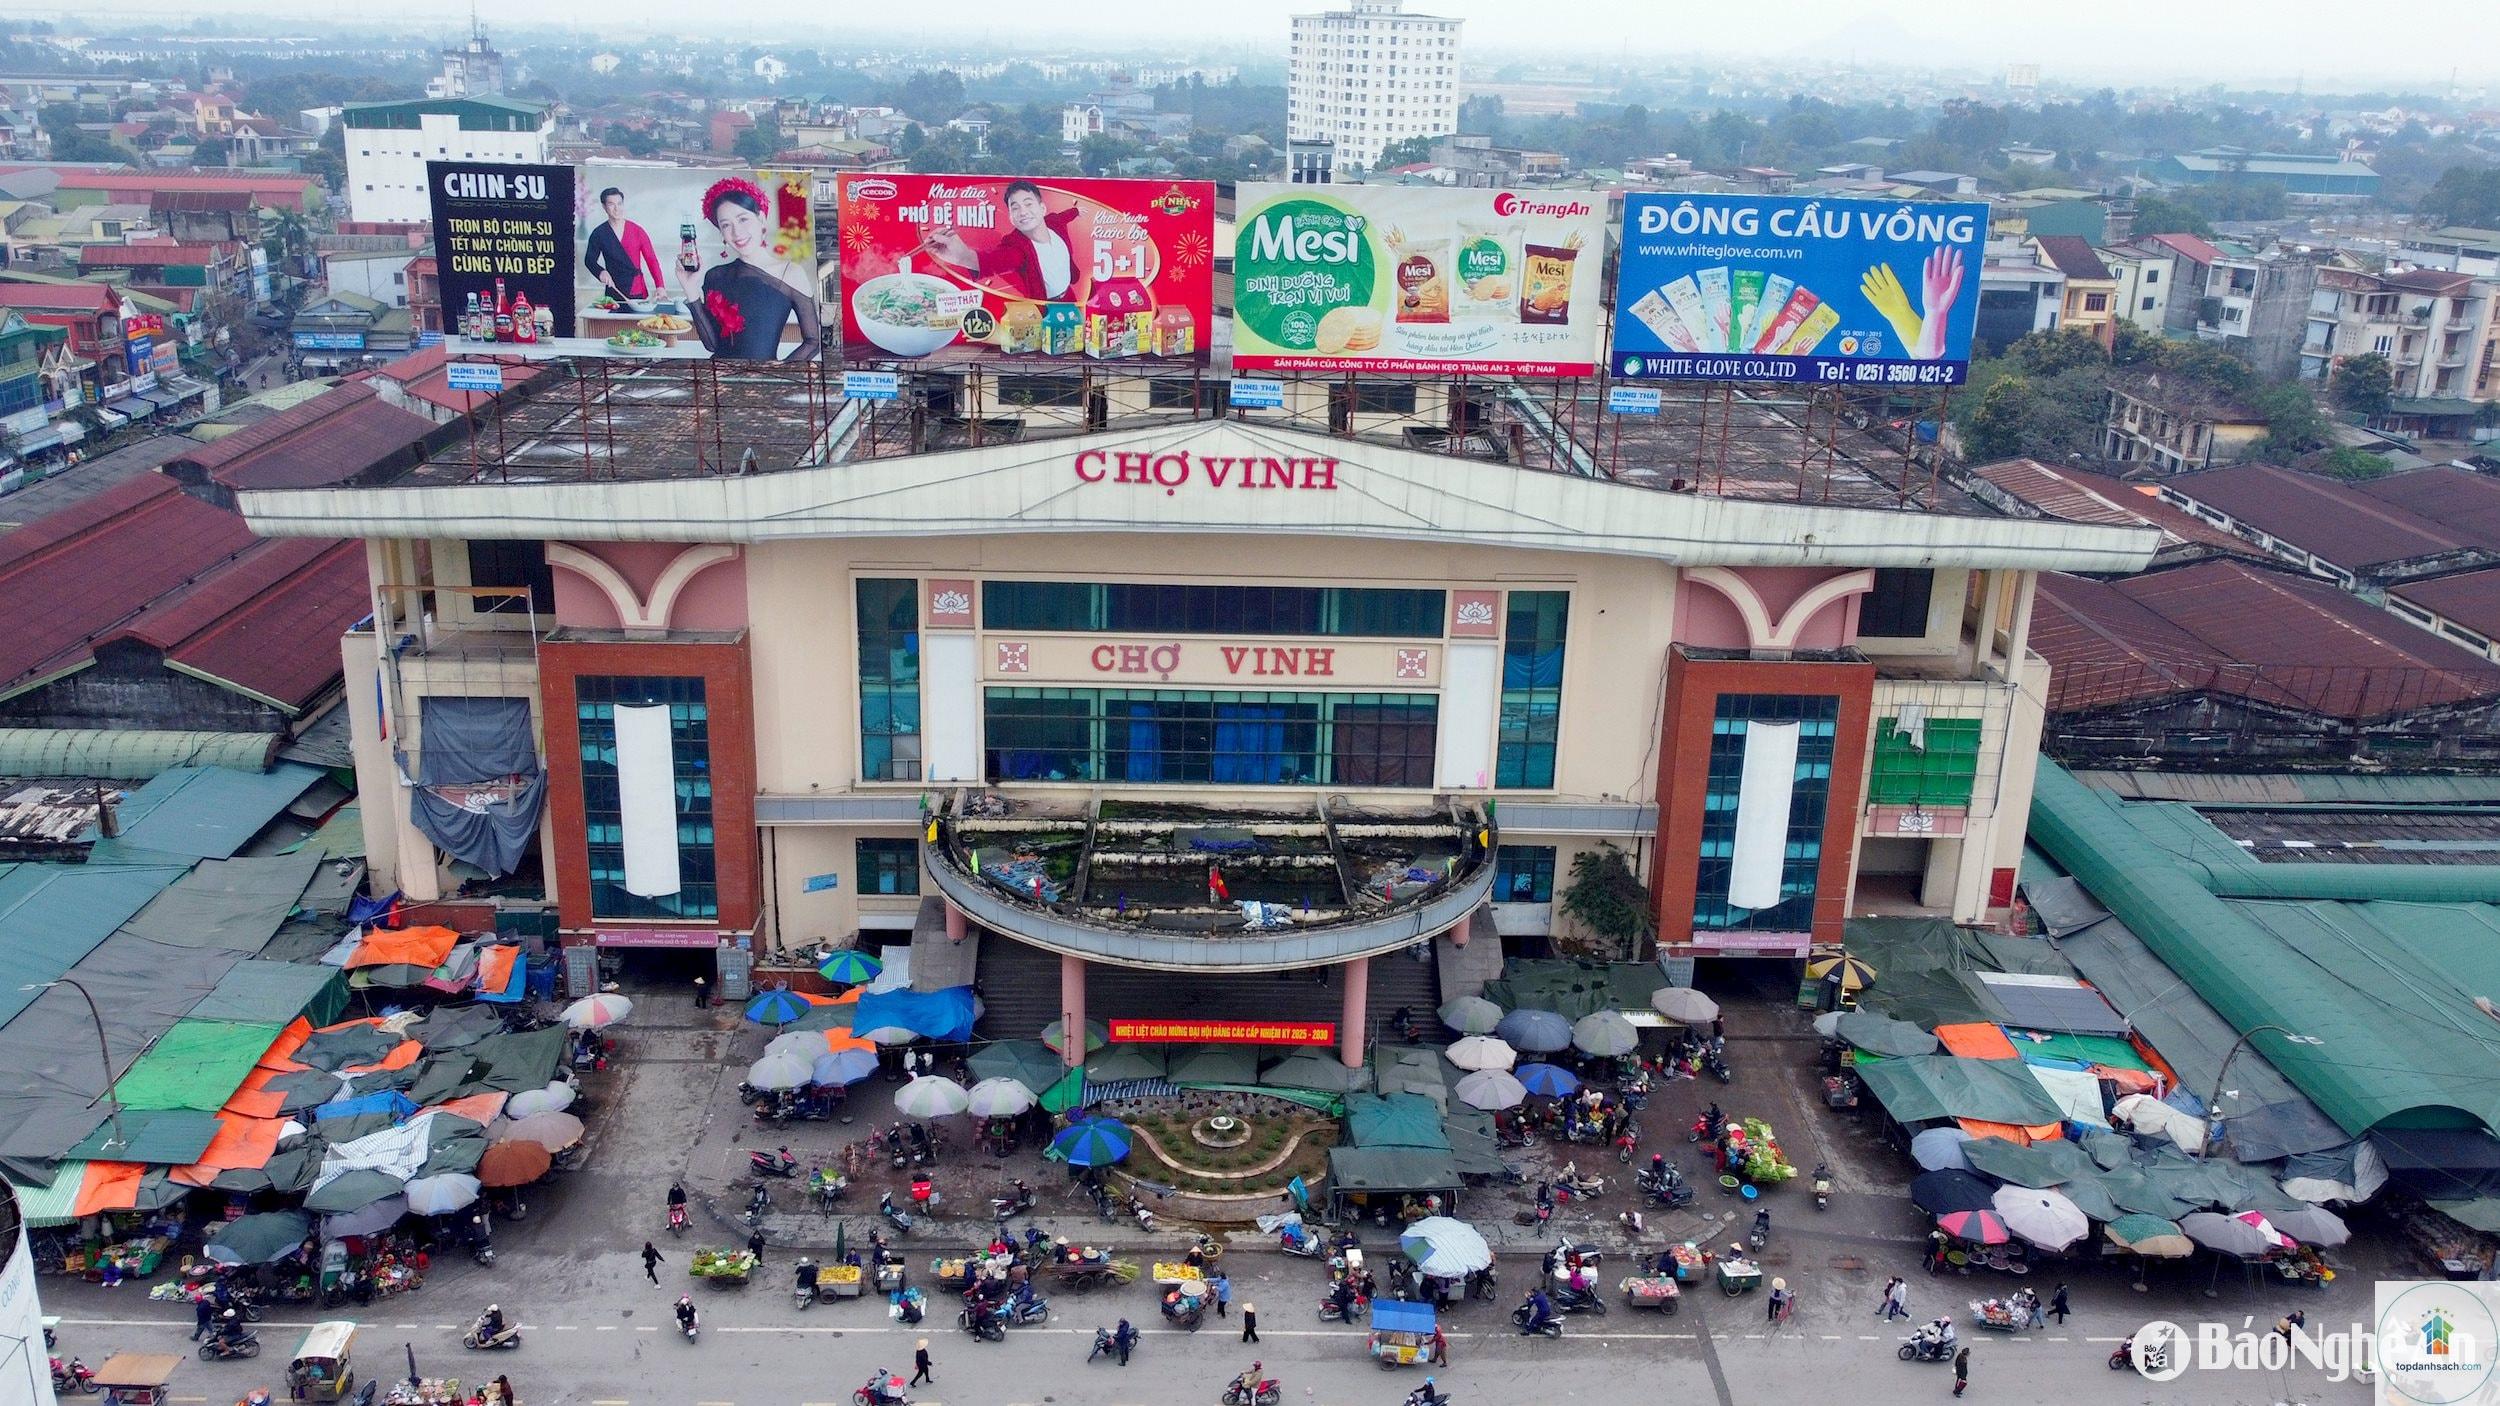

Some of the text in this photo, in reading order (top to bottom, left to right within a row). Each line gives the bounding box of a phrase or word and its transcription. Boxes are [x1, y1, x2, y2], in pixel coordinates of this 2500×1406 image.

[444, 173, 546, 199] CHIN-SU
[928, 183, 957, 199] Khai
[898, 200, 996, 229] PHỞ ĐỆ NHẤT
[1093, 211, 1118, 225] Khai
[1638, 200, 1974, 243] ĐÔNG CẦU VỒNG
[448, 217, 552, 236] TRỌN BỘ CHIN-SU
[450, 235, 469, 251] TẾT
[472, 237, 493, 251] NÀY
[536, 241, 554, 253] VUI
[1251, 214, 1364, 263] Mesi
[1093, 240, 1145, 282] 5+1
[1469, 250, 1502, 265] Mesi
[1639, 243, 1803, 260] www.whiteglove.com.vn
[452, 253, 555, 274] CÙNG VÀO BẾP
[1405, 264, 1432, 277] Mesi
[1536, 262, 1567, 276] Mesi
[1246, 271, 1335, 292] DINH DƯỠNG
[1268, 283, 1350, 307] TRỌN VỊ VUI
[1274, 358, 1291, 367] SẢN
[1293, 358, 1318, 368] PHẨM
[1319, 359, 1337, 369] CỦA
[1339, 359, 1363, 369] CÔNG
[1364, 361, 1375, 369] TY
[1415, 361, 1440, 371] BÁNH
[1441, 363, 1459, 373] KẸO
[1460, 362, 1488, 372] TRÀNG
[1517, 363, 1535, 374] VIỆT
[1646, 359, 1796, 378] WHITE GLOVE CO.,LTD
[1817, 362, 1954, 382] Tel: 0251 3560 421-2
[1074, 450, 1340, 496] CHỢ VINH
[1091, 642, 1335, 681] CHỢ VINH
[1115, 1024, 1135, 1039] NHIỆT
[1136, 1024, 1149, 1039] LIỆT
[1150, 1024, 1167, 1037] CHÀO
[1168, 1024, 1187, 1037] MỪNG
[1188, 1026, 1200, 1039] ĐẠI
[1201, 1025, 1212, 1039] HỘI
[1212, 1024, 1230, 1037] ĐẢNG
[1231, 1025, 1245, 1038] CÁC
[1246, 1024, 1259, 1038] CẤP
[1260, 1026, 1280, 1040] NHIỆM
[1291, 1028, 1307, 1040] 2025
[1312, 1029, 1328, 1040] 2030
